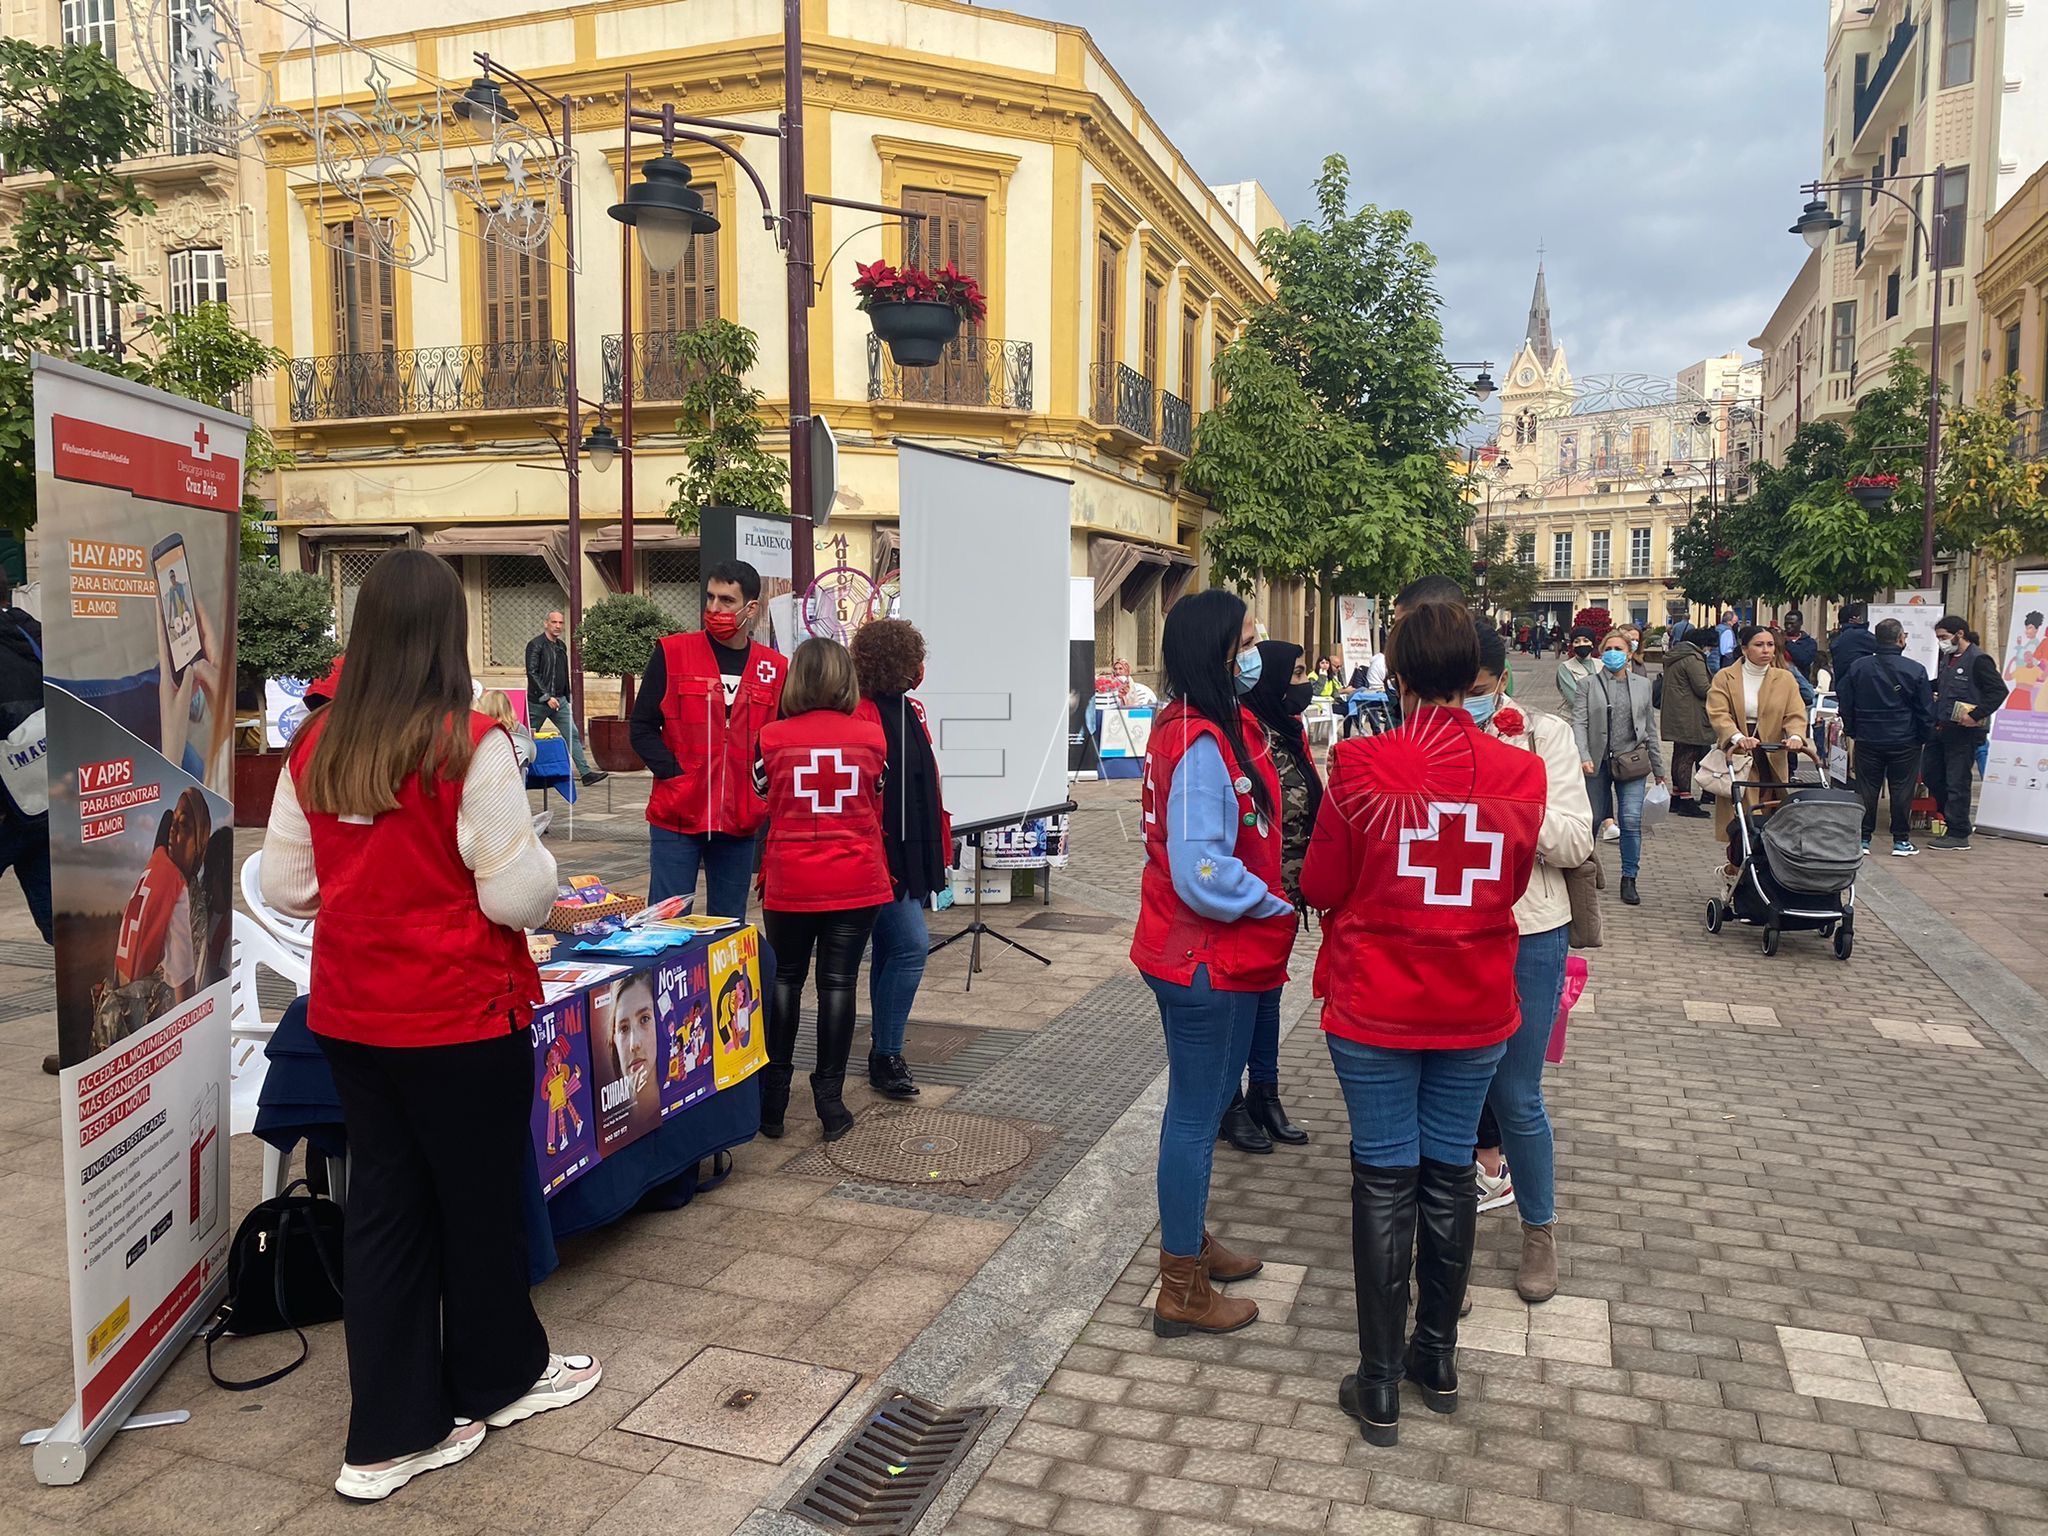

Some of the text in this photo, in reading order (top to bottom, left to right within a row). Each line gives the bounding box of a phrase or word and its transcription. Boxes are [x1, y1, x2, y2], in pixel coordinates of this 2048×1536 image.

[177, 460, 203, 477] Descarga
[216, 470, 226, 482] app
[186, 477, 218, 500] Cruz Roja
[745, 533, 792, 550] FLAMENCO
[71, 543, 143, 569] HAY APPS
[72, 576, 155, 593] PARA ENCONTRAR
[73, 600, 117, 614] EL AMOR
[7, 750, 29, 768] I'M
[31, 745, 40, 760] A
[81, 760, 131, 788] Y APPS
[83, 786, 159, 814] PARA ENCONTRAR
[84, 817, 123, 838] EL AMOR
[983, 832, 1038, 850] BLES
[712, 949, 728, 976] NO
[658, 967, 675, 996] NO
[78, 1000, 214, 1095] ACCEDE AL MOVIMIENTO SOLIDARIO
[79, 1095, 101, 1119] MÁS
[103, 1072, 139, 1104] GRANDE
[138, 1061, 153, 1080] DEL
[80, 1113, 112, 1146] DESDE
[112, 1107, 124, 1124] TU
[81, 1111, 167, 1183] FUNCIONES DESTACADAS
